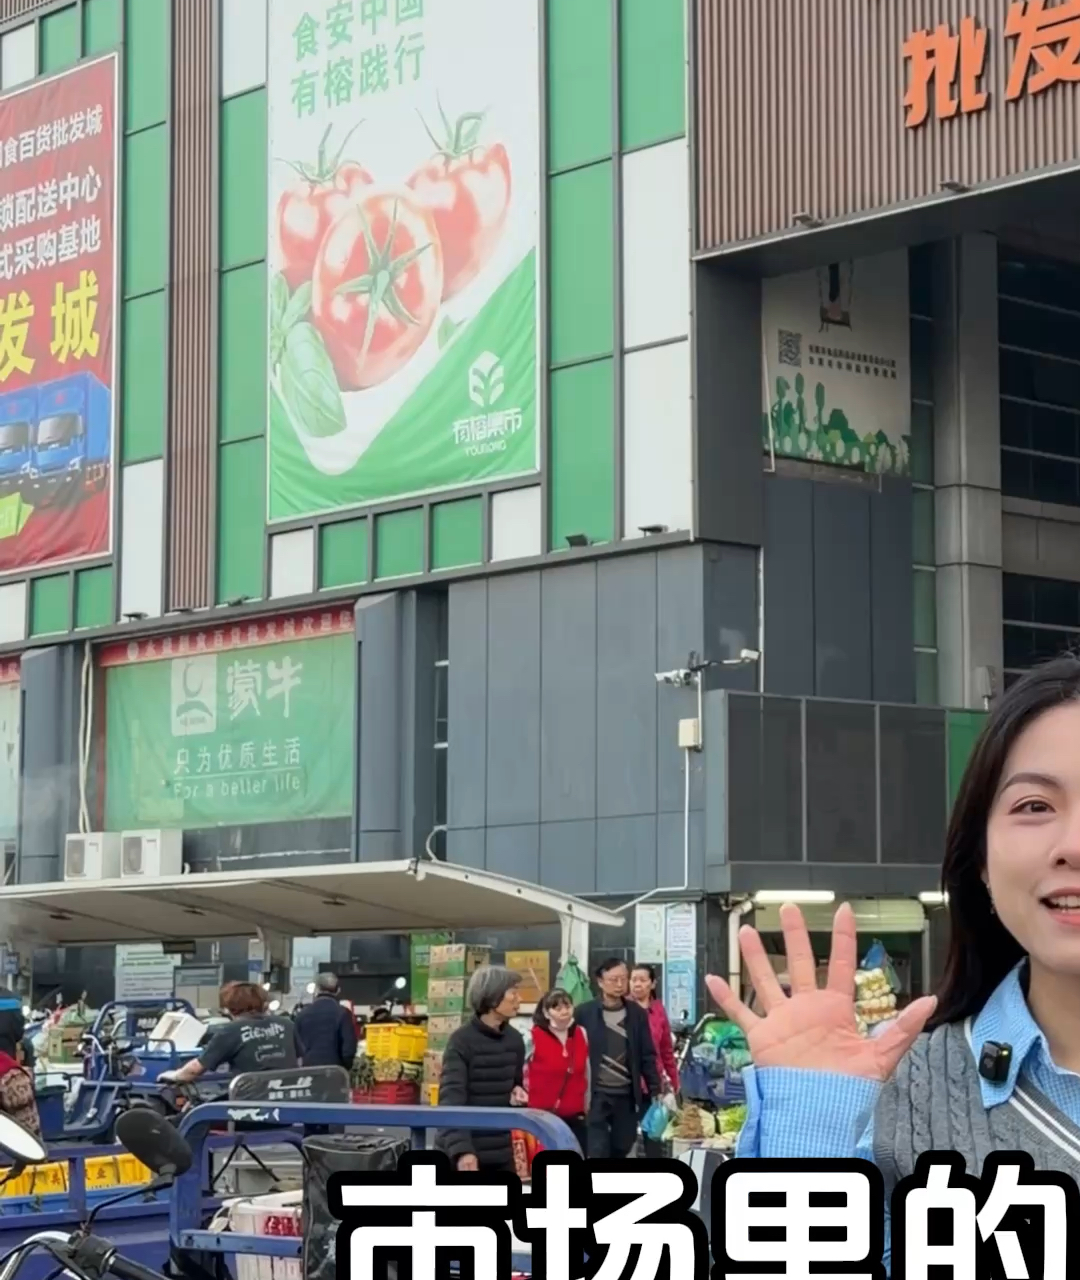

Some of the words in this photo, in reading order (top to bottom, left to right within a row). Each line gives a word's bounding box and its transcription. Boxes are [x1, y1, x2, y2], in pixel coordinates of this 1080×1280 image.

[290, 32, 425, 119] 有榕践行
[0, 103, 103, 169] 食百货批发城
[226, 655, 303, 720] 蒙牛
[173, 736, 301, 774] 只为优质生活
[174, 782, 199, 800] For
[206, 783, 214, 797] a
[221, 776, 267, 796] better
[275, 772, 301, 793] life
